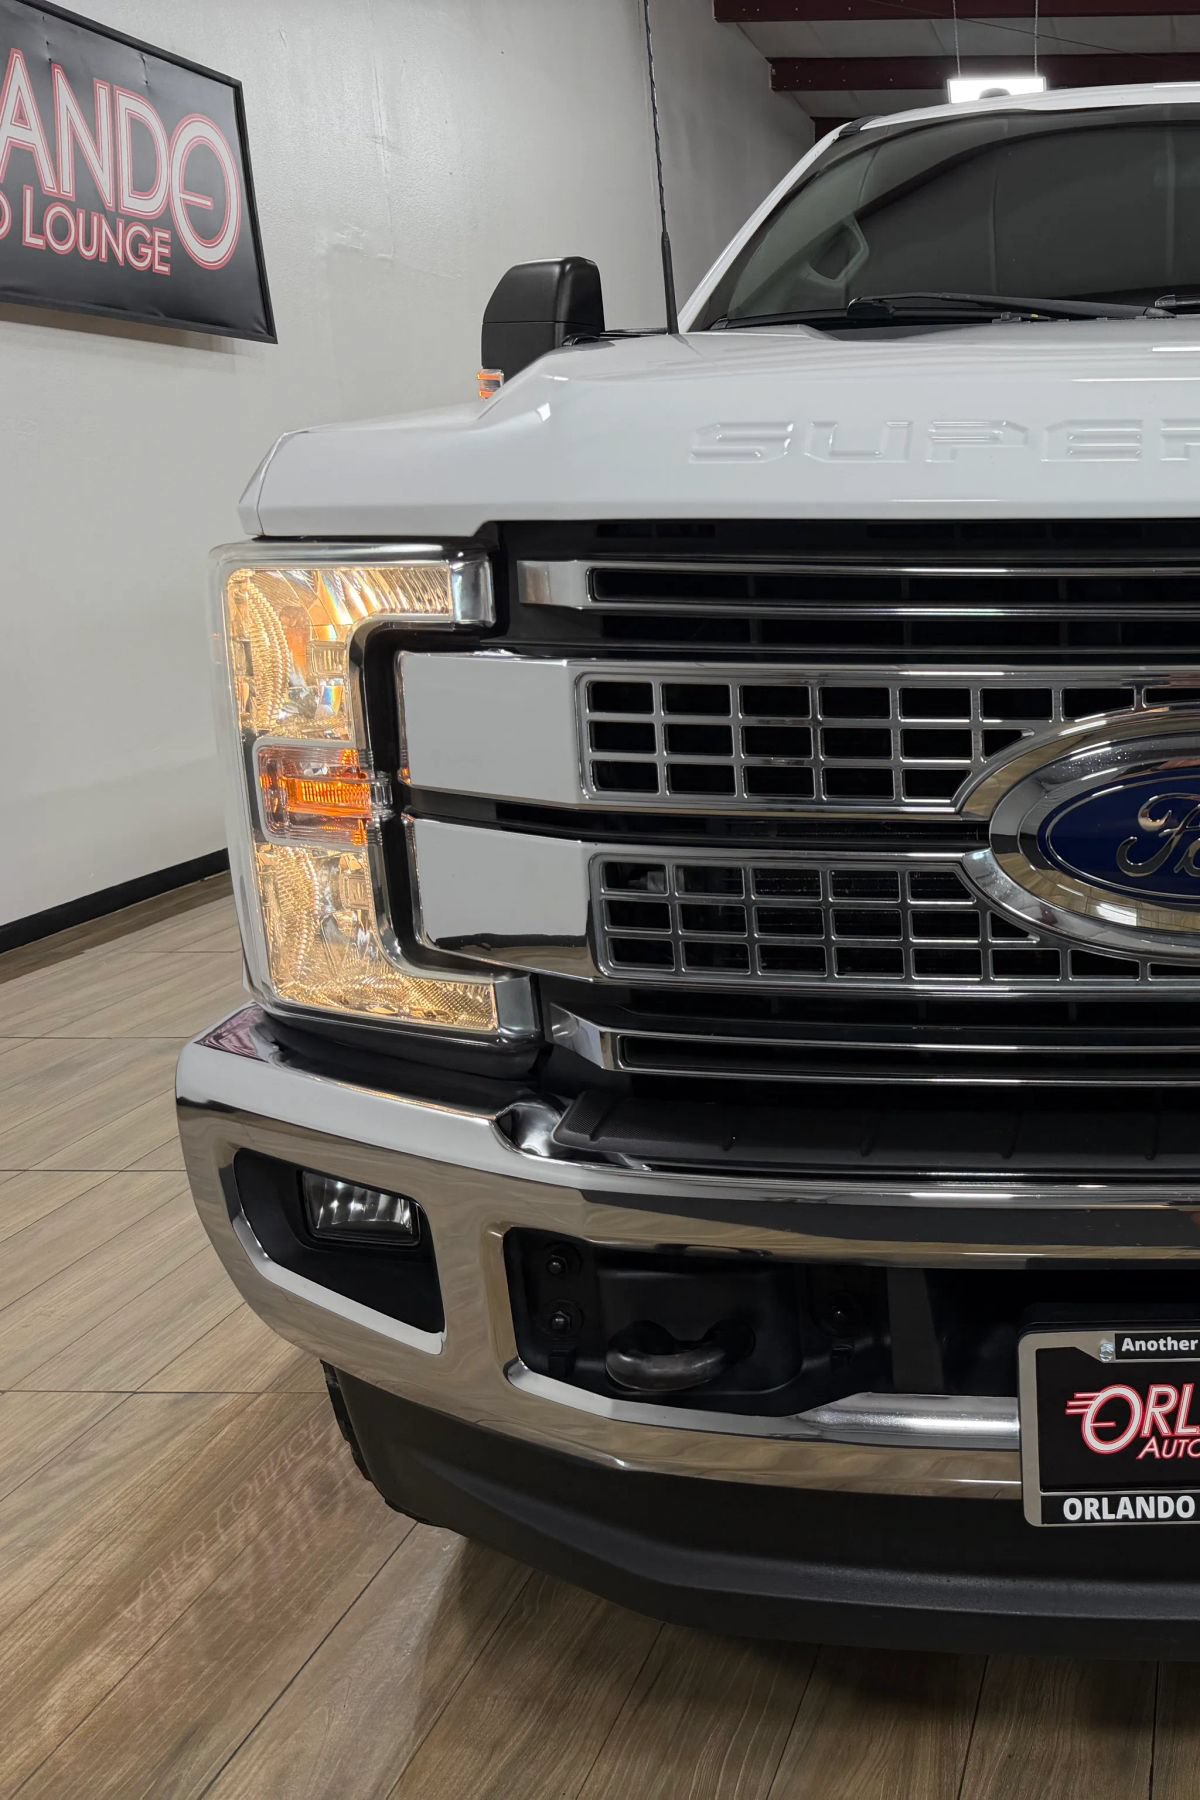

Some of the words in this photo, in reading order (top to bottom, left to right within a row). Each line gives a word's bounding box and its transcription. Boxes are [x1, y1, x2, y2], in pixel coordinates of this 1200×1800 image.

[23, 185, 171, 275] LOUNGE
[1121, 1336, 1199, 1352] Another
[1062, 1496, 1196, 1521] ORLANDO
